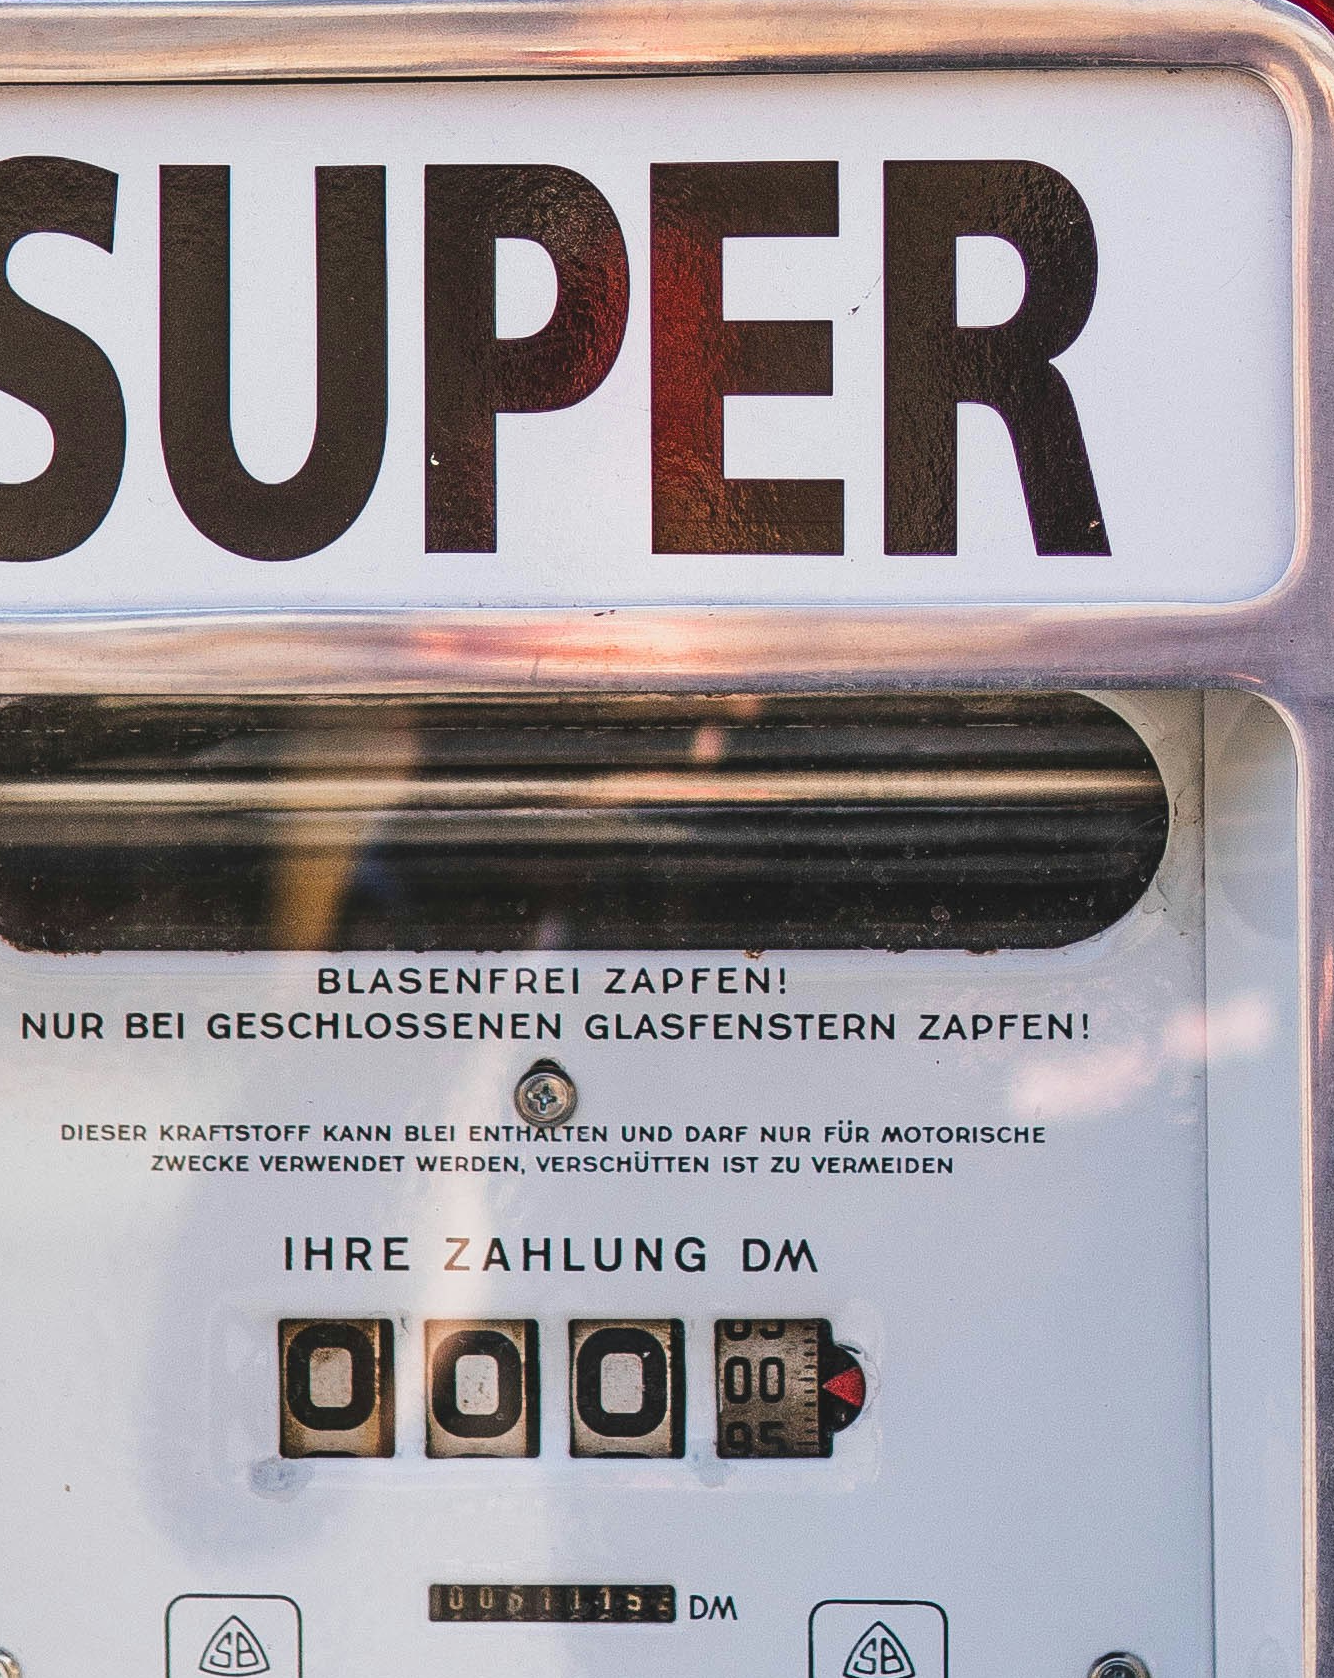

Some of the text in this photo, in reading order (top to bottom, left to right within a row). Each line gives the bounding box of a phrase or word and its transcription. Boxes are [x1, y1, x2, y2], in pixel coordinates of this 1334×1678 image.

[317, 966, 786, 996] BLASENFREI ZAPFEN!
[21, 1011, 1090, 1042] NUR BEI GESCHLOSSENEN GLASFENSTERN ZAPFEN!
[60, 1119, 1047, 1145] DIESER KRAFTSTOFF KANN BLEI ENTHALTEN UND DARF NUR FÜR MOTORISCHE
[150, 1150, 954, 1177] ZWECKE VERWENDET WERDEN, VERSCHÜTTEN IST ZU VERMEIDEN
[284, 1236, 819, 1274] IHRE ZAHLUNG DM
[688, 1594, 739, 1621] DM
[210, 1631, 259, 1668] SB
[853, 1637, 905, 1675] SB
